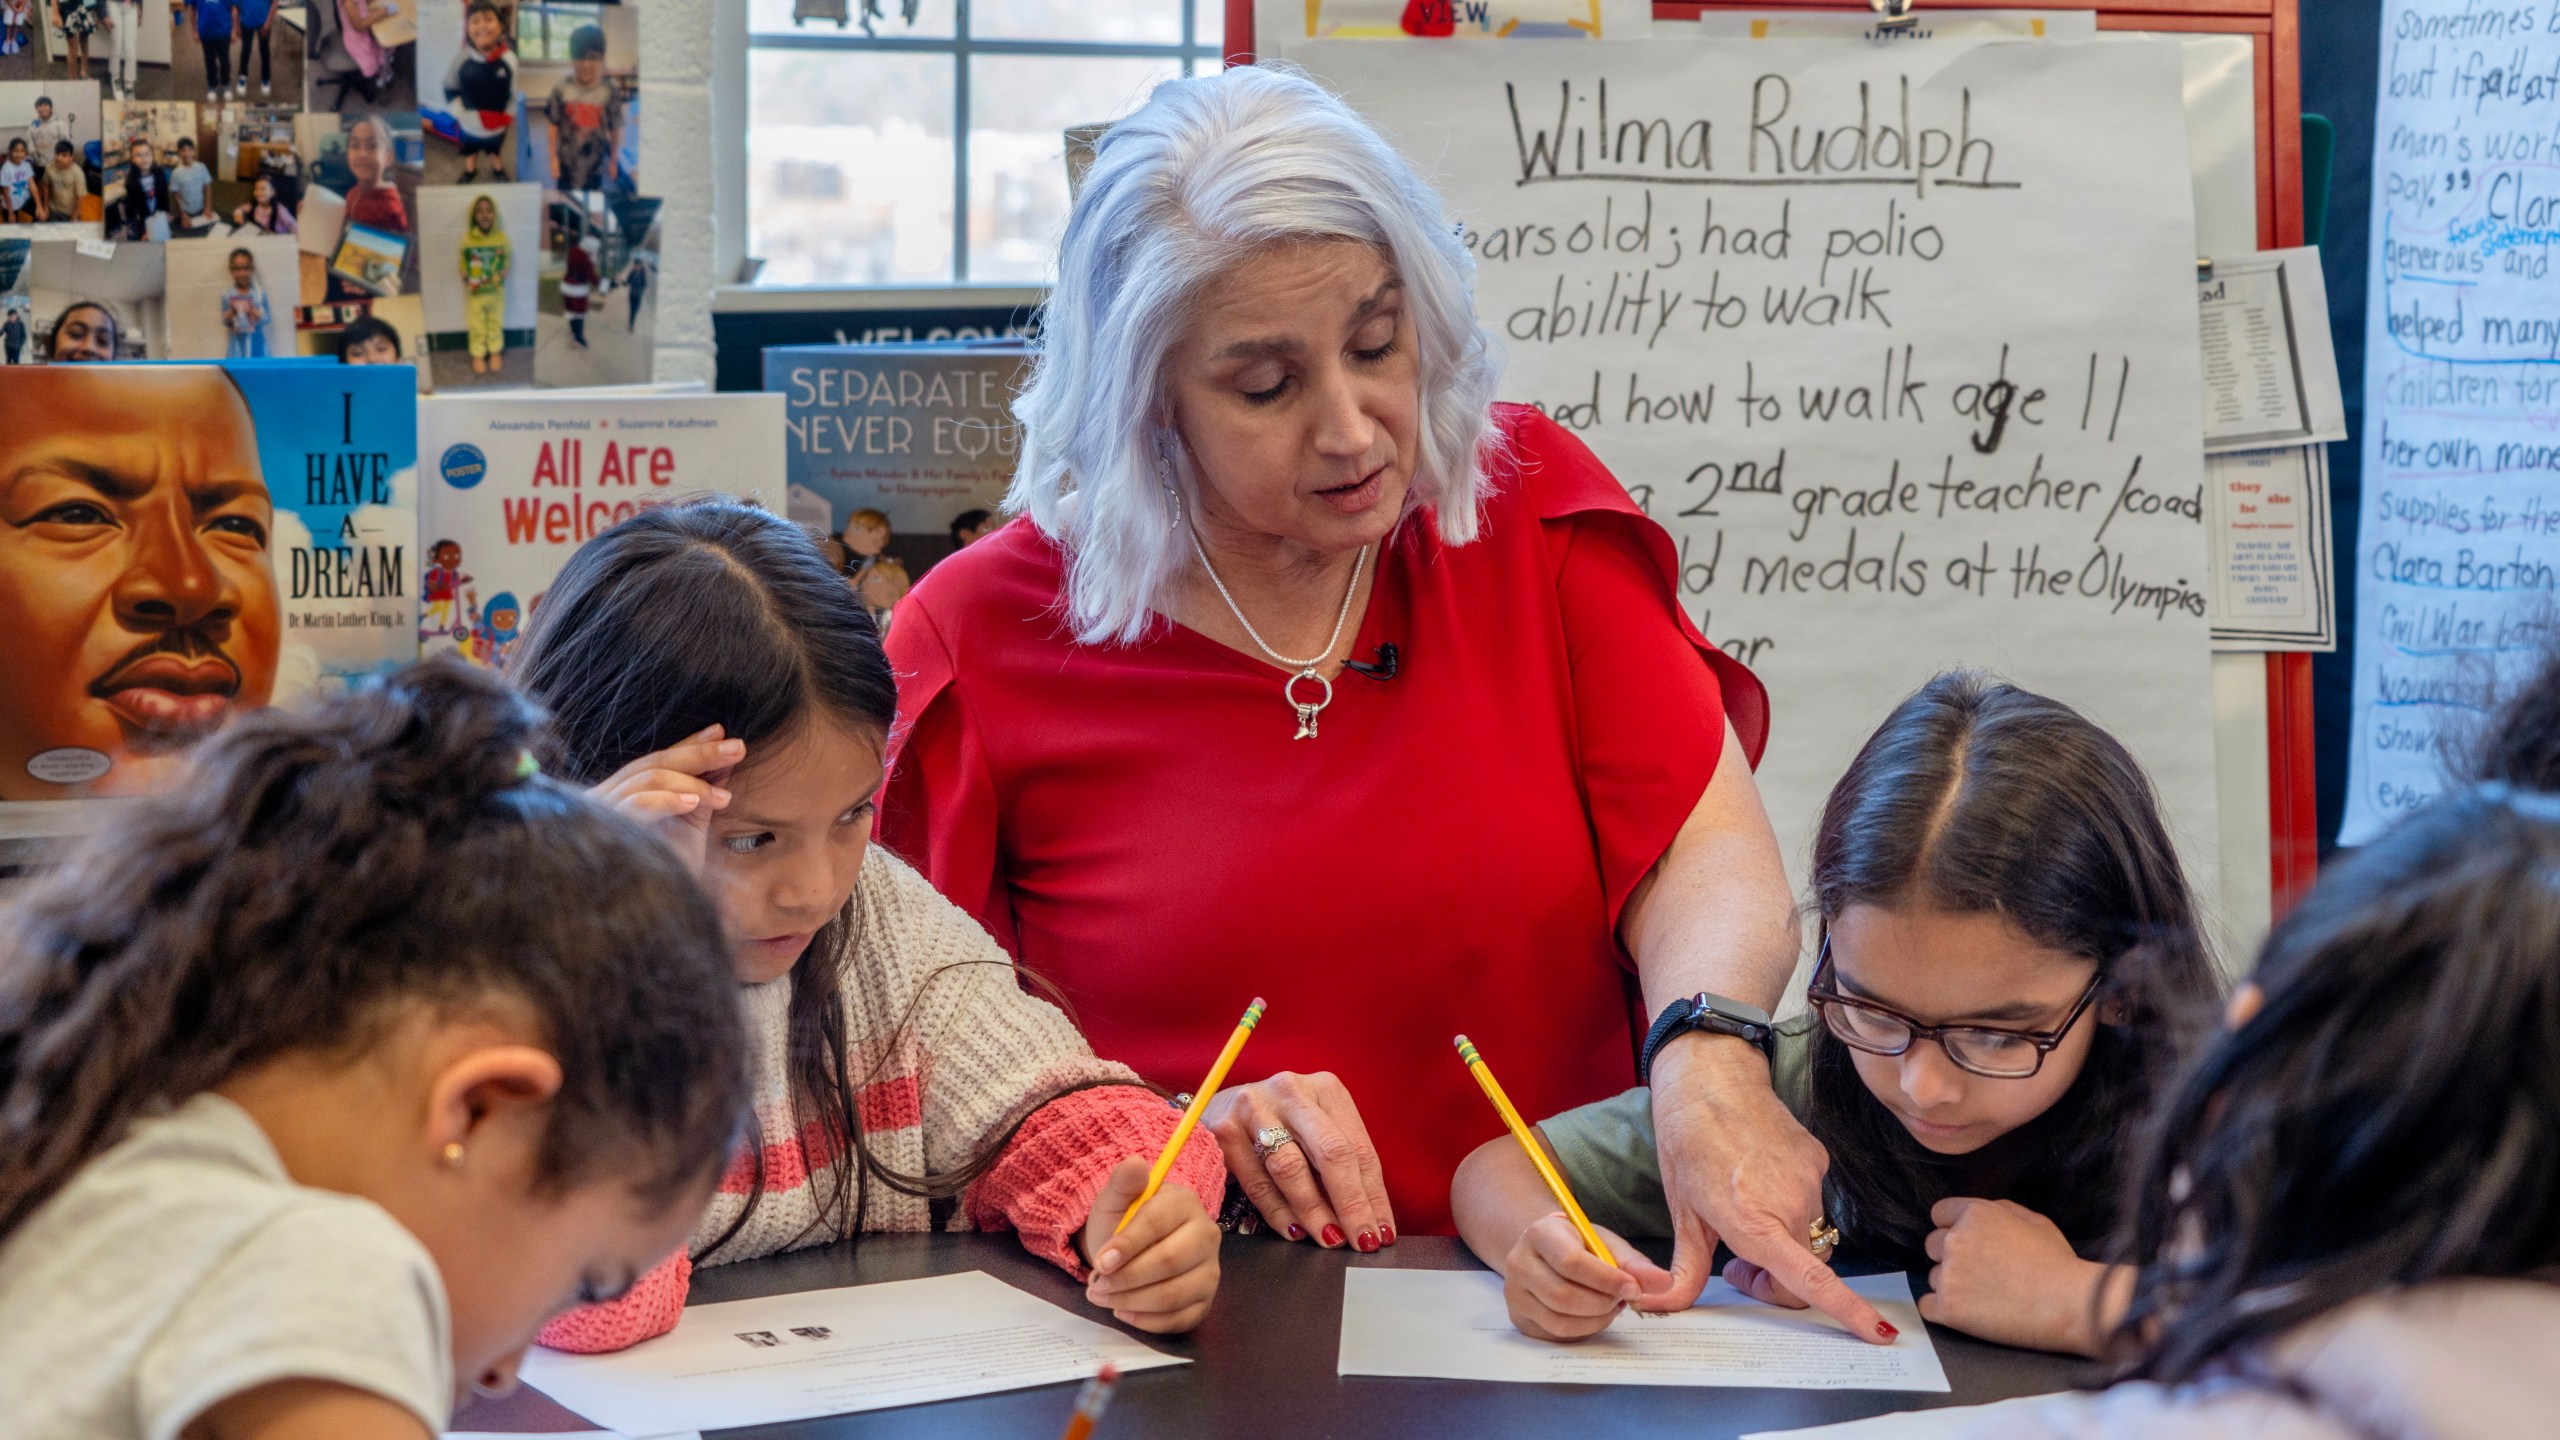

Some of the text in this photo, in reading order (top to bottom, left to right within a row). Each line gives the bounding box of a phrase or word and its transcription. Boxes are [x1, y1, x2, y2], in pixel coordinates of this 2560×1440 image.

[2389, 42, 2437, 99] but
[1506, 72, 1996, 200] Wilma Rudolph
[1454, 219, 1557, 264] ears
[1699, 197, 1793, 261] had
[1819, 198, 1945, 289] polio
[2385, 236, 2550, 285] generous and
[1506, 265, 1893, 351] ability to walk
[2387, 297, 2464, 352] helped
[789, 367, 999, 409] SEPARATE
[1624, 371, 1715, 424] how
[1736, 359, 1782, 429] to
[1798, 342, 1929, 424] walk
[341, 392, 354, 445] I
[305, 453, 389, 506] HAVE
[532, 437, 581, 488] All
[598, 440, 675, 487] Are
[1789, 458, 1922, 542] grade
[1926, 453, 2102, 519] teacher
[339, 514, 356, 539] A
[290, 546, 405, 599] DREAM
[1742, 526, 1928, 596] medals
[1946, 540, 1999, 597] at
[2009, 543, 2074, 599] the
[2077, 543, 2207, 622] Olympics
[2373, 541, 2555, 593] Clara Barton
[288, 612, 302, 629] Dr.
[303, 612, 335, 629] Martin
[336, 611, 368, 628] Luther
